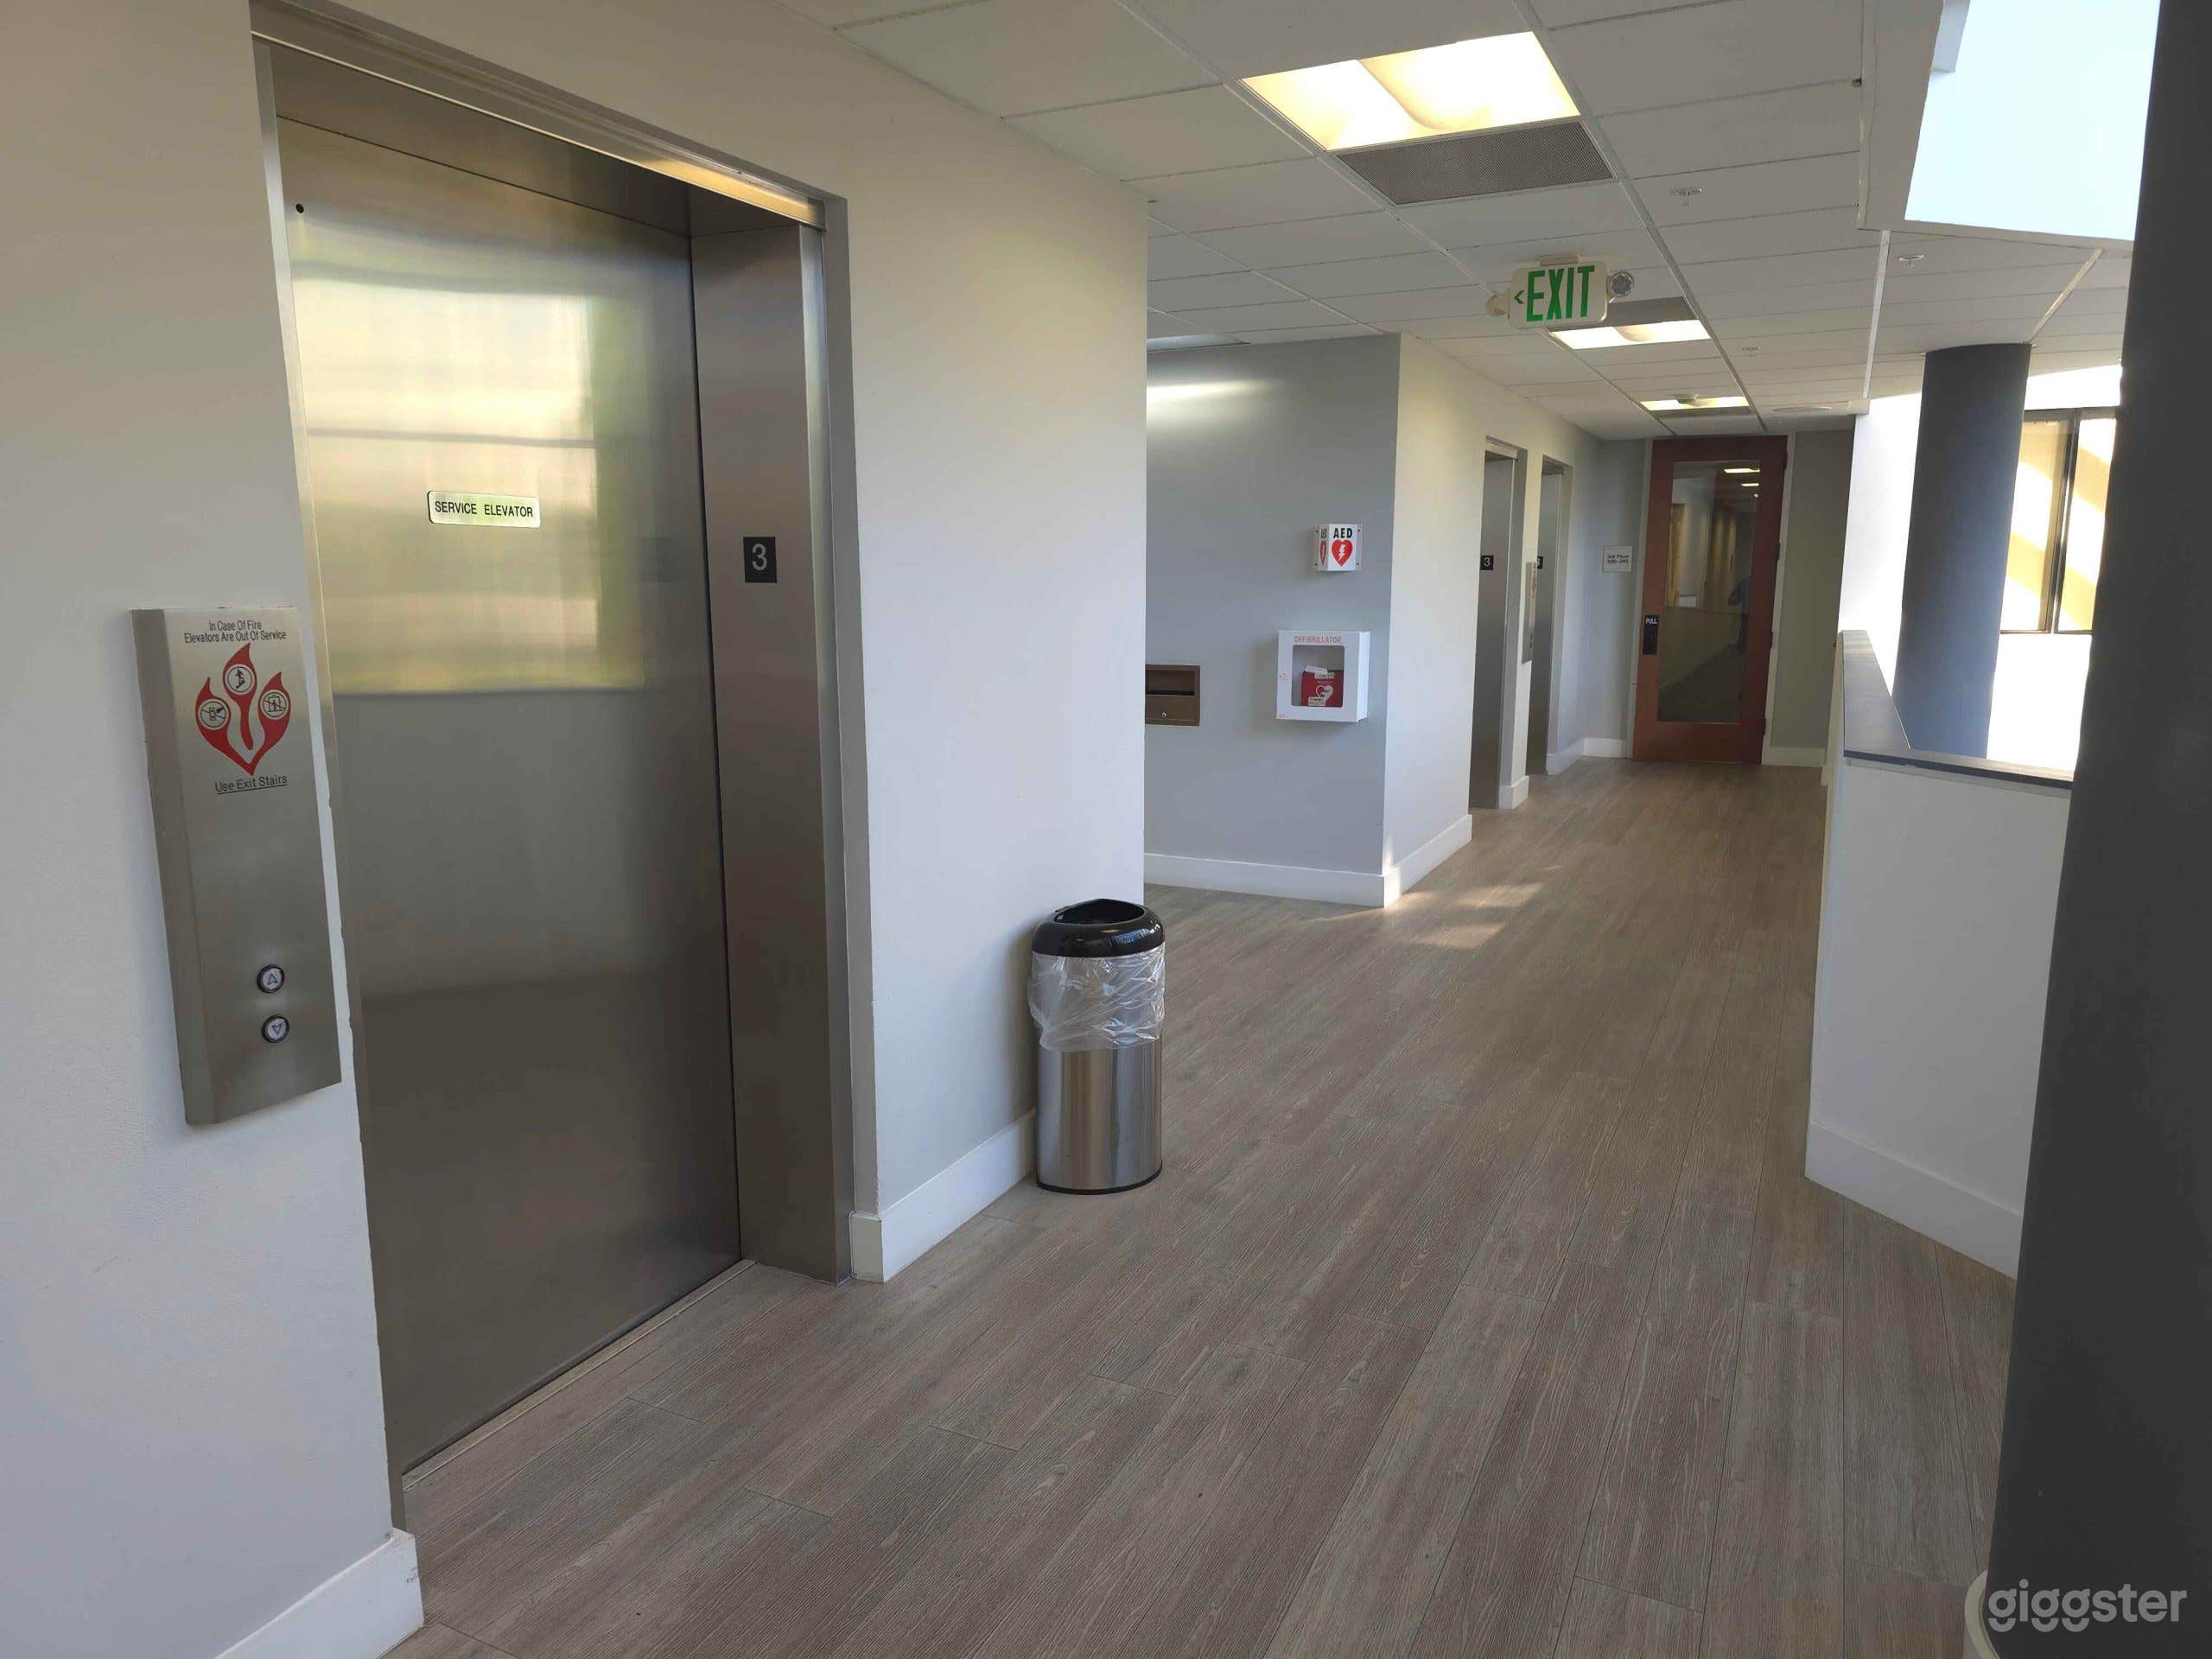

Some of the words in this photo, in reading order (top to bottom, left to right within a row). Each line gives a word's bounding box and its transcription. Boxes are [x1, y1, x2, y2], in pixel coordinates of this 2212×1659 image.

[1526, 265, 1595, 322] EXIT
[435, 500, 477, 515] SERVICE
[484, 503, 534, 518] ELEVATOR
[1333, 528, 1353, 538] AED
[753, 543, 768, 571] 3
[1484, 556, 1491, 567] 3
[209, 621, 216, 631] In
[217, 620, 235, 631] Case
[238, 620, 245, 630] Of
[247, 620, 262, 630] Fire
[184, 632, 219, 643] Elevators
[222, 632, 234, 642] Are
[236, 631, 249, 642] Out
[251, 630, 259, 641] Of
[260, 629, 287, 640] Service
[1294, 635, 1342, 644] DEFIBRILLATOR
[214, 780, 234, 792] Use
[236, 778, 257, 790] Exit
[258, 774, 288, 787] Stairs
